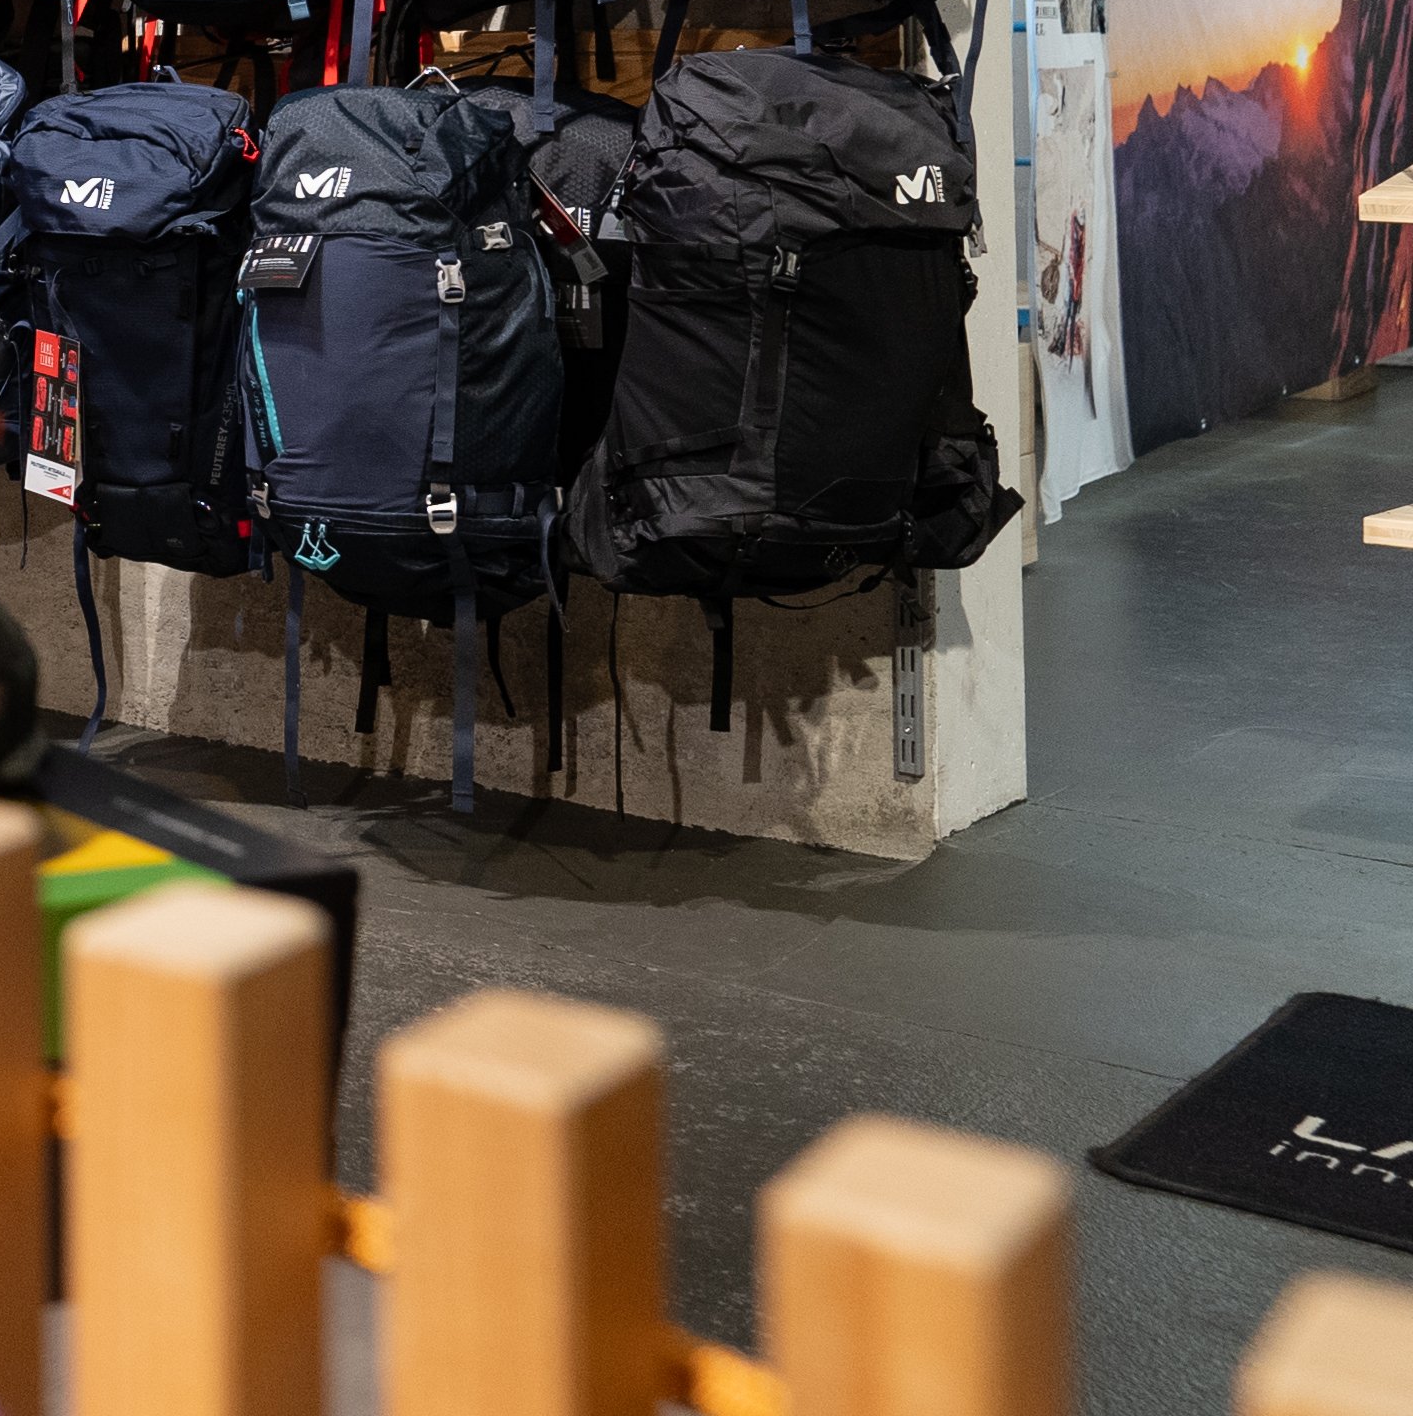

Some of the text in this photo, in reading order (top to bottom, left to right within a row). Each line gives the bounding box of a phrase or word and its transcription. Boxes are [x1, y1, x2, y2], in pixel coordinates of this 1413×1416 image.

[101, 178, 116, 210] MILLET
[336, 166, 353, 198] MILLET
[581, 207, 591, 236] ILLET
[210, 426, 229, 486] PEUTEREY
